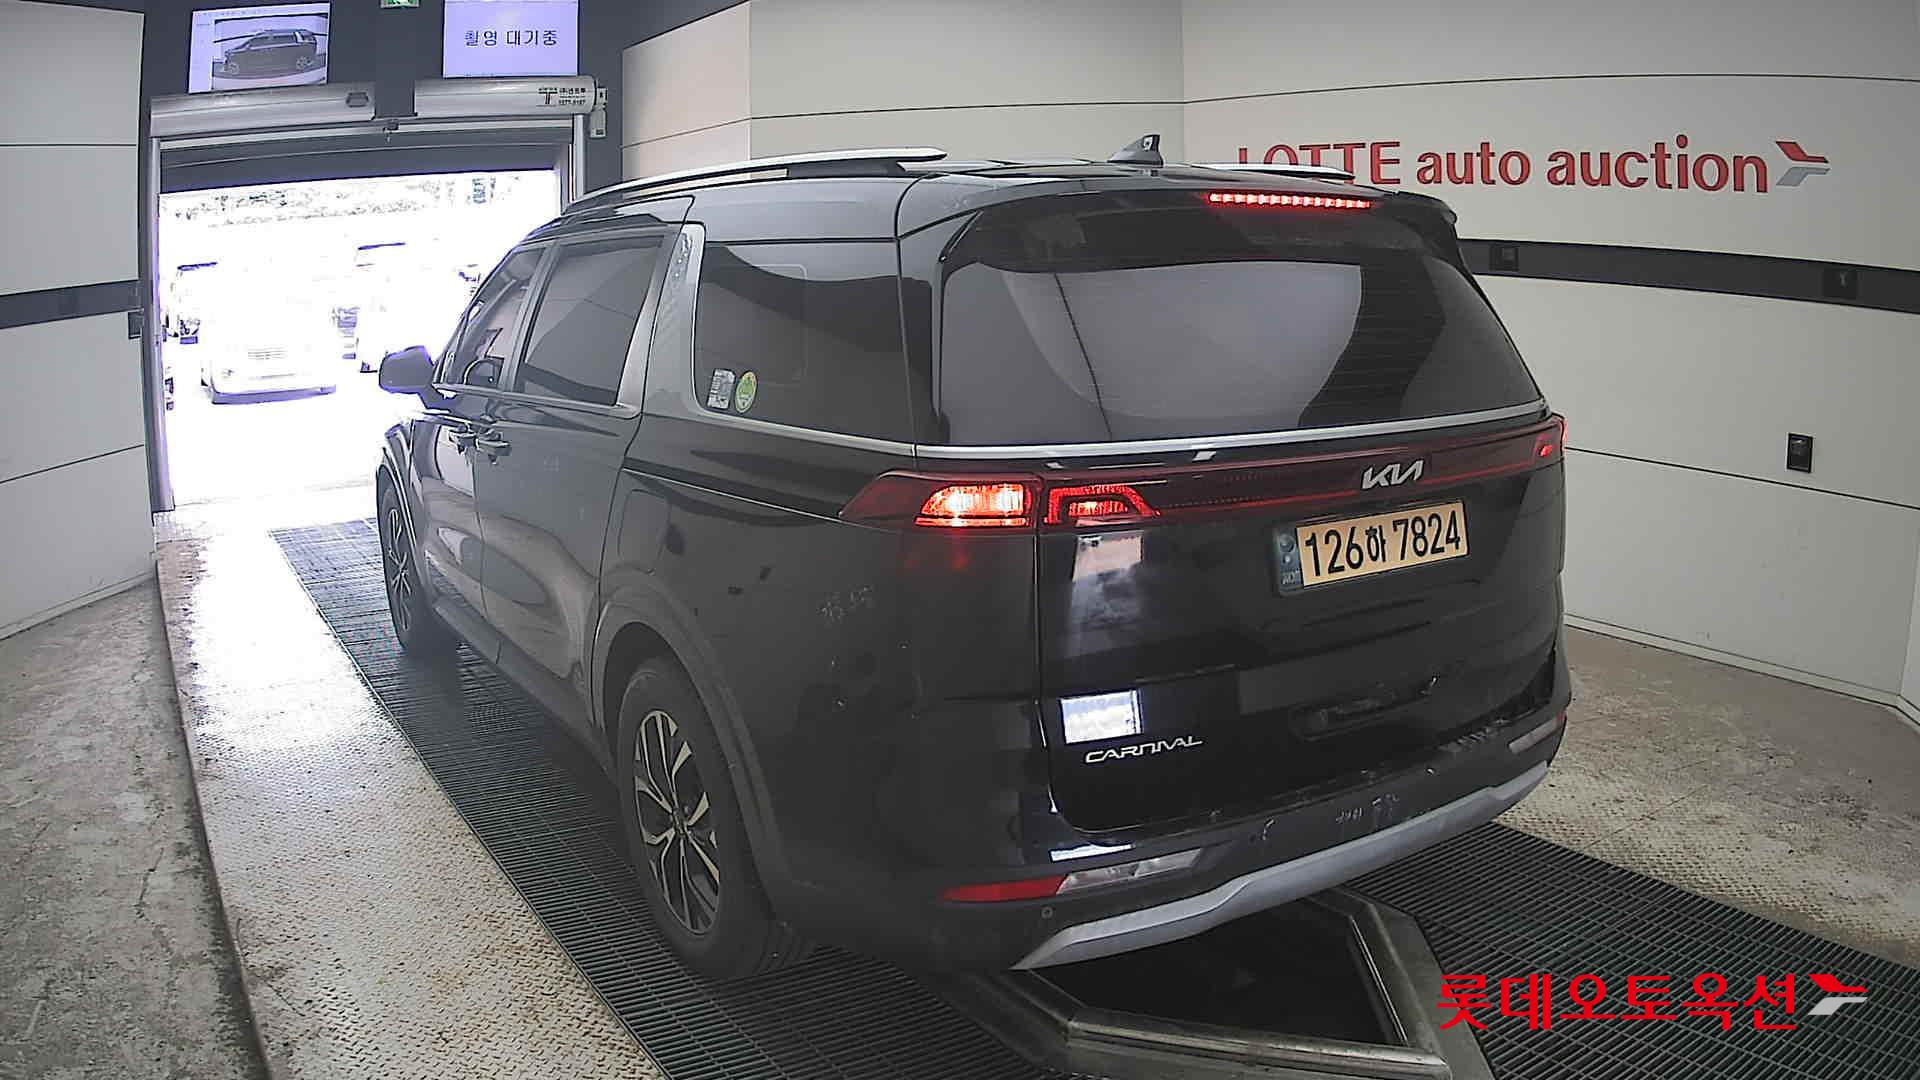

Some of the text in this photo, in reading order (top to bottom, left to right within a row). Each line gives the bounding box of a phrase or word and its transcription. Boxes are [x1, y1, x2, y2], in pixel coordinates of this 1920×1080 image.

[465, 30, 558, 46] 촬영 대기중
[1416, 142, 1531, 186] auto
[1547, 134, 1768, 193] auction
[1305, 509, 1461, 577] 126하 7824
[1085, 735, 1203, 763] CARNIVAL
